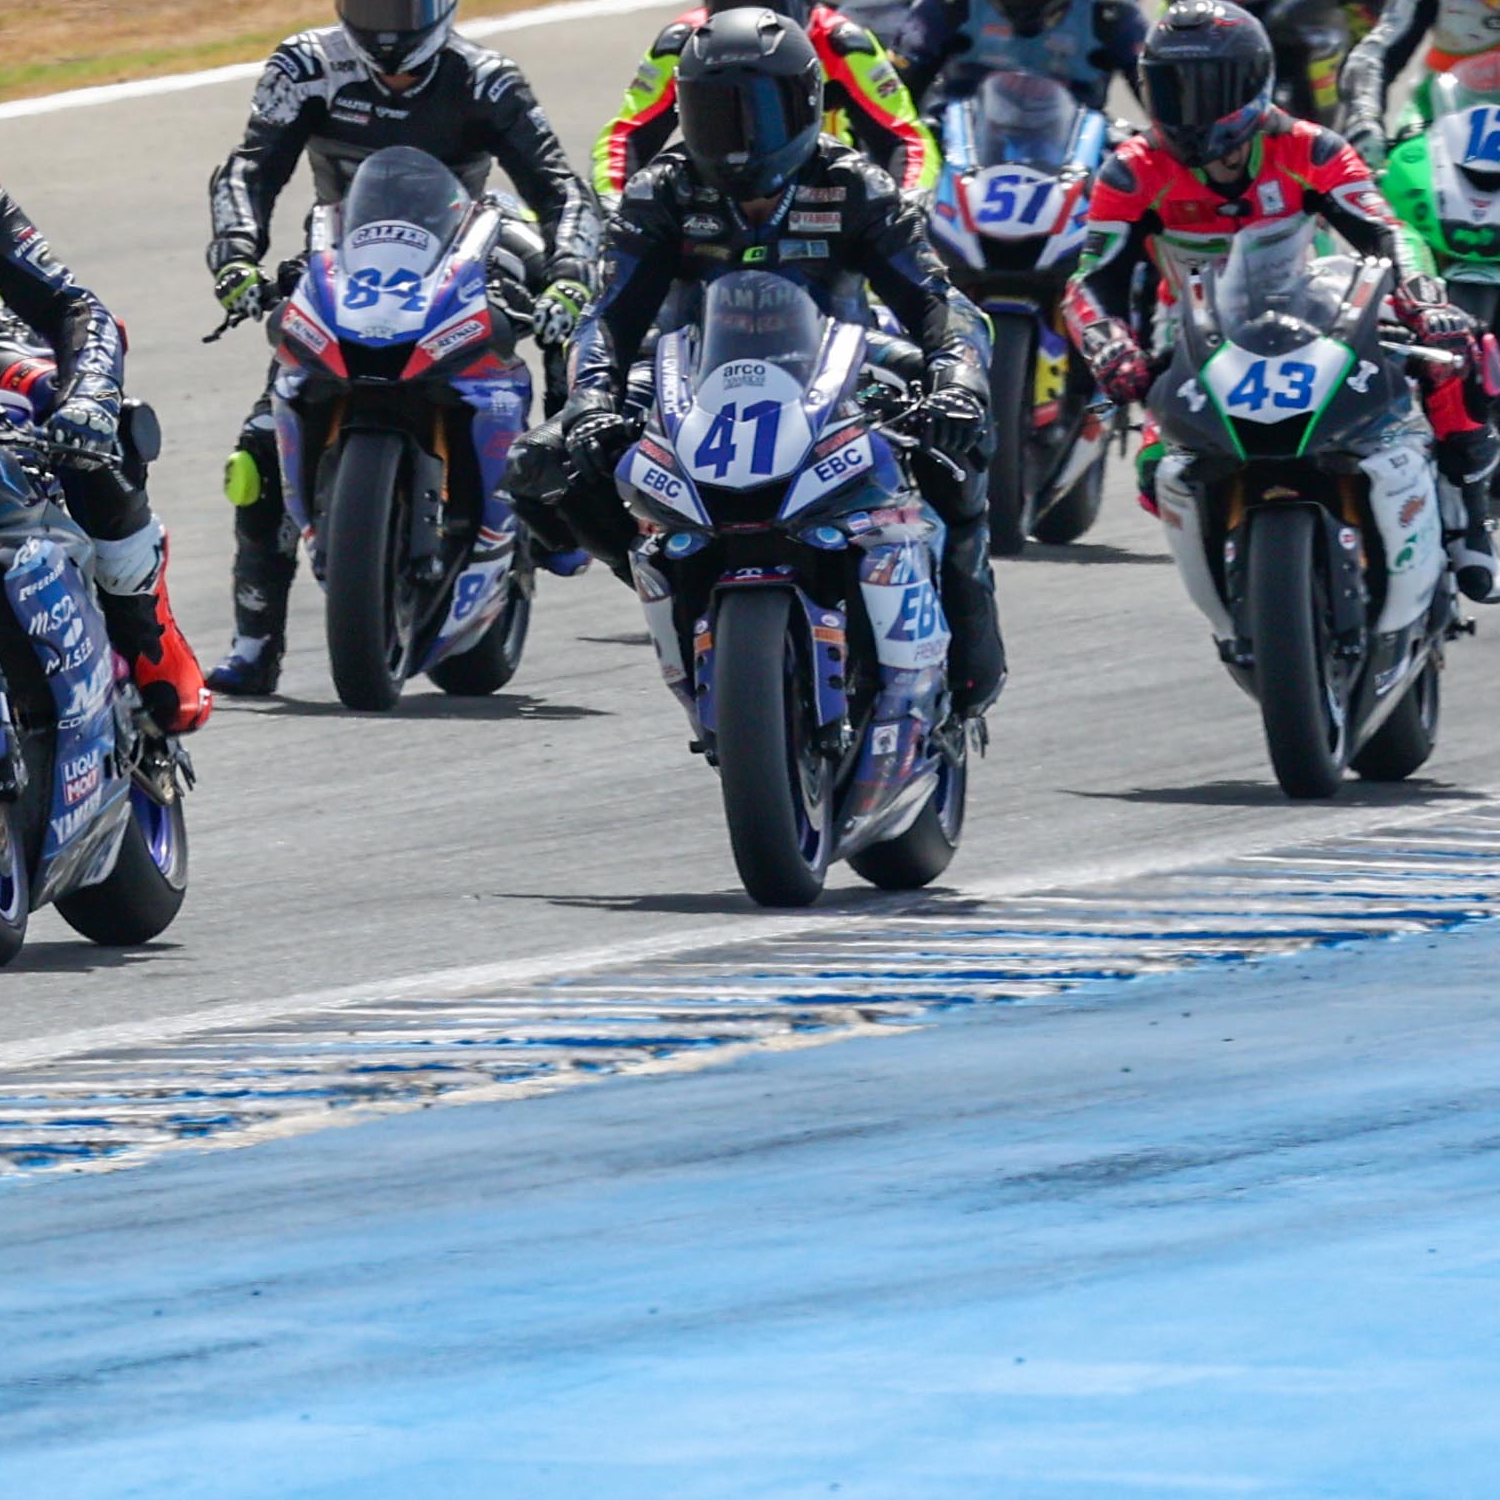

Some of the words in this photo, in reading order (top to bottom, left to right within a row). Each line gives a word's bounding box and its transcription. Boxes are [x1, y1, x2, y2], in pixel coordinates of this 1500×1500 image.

[353, 226, 428, 245] GALFER
[723, 363, 765, 376] arco
[1227, 360, 1316, 411] 43
[695, 400, 782, 479] 41
[814, 448, 863, 483] EBC
[643, 467, 682, 498] EBC
